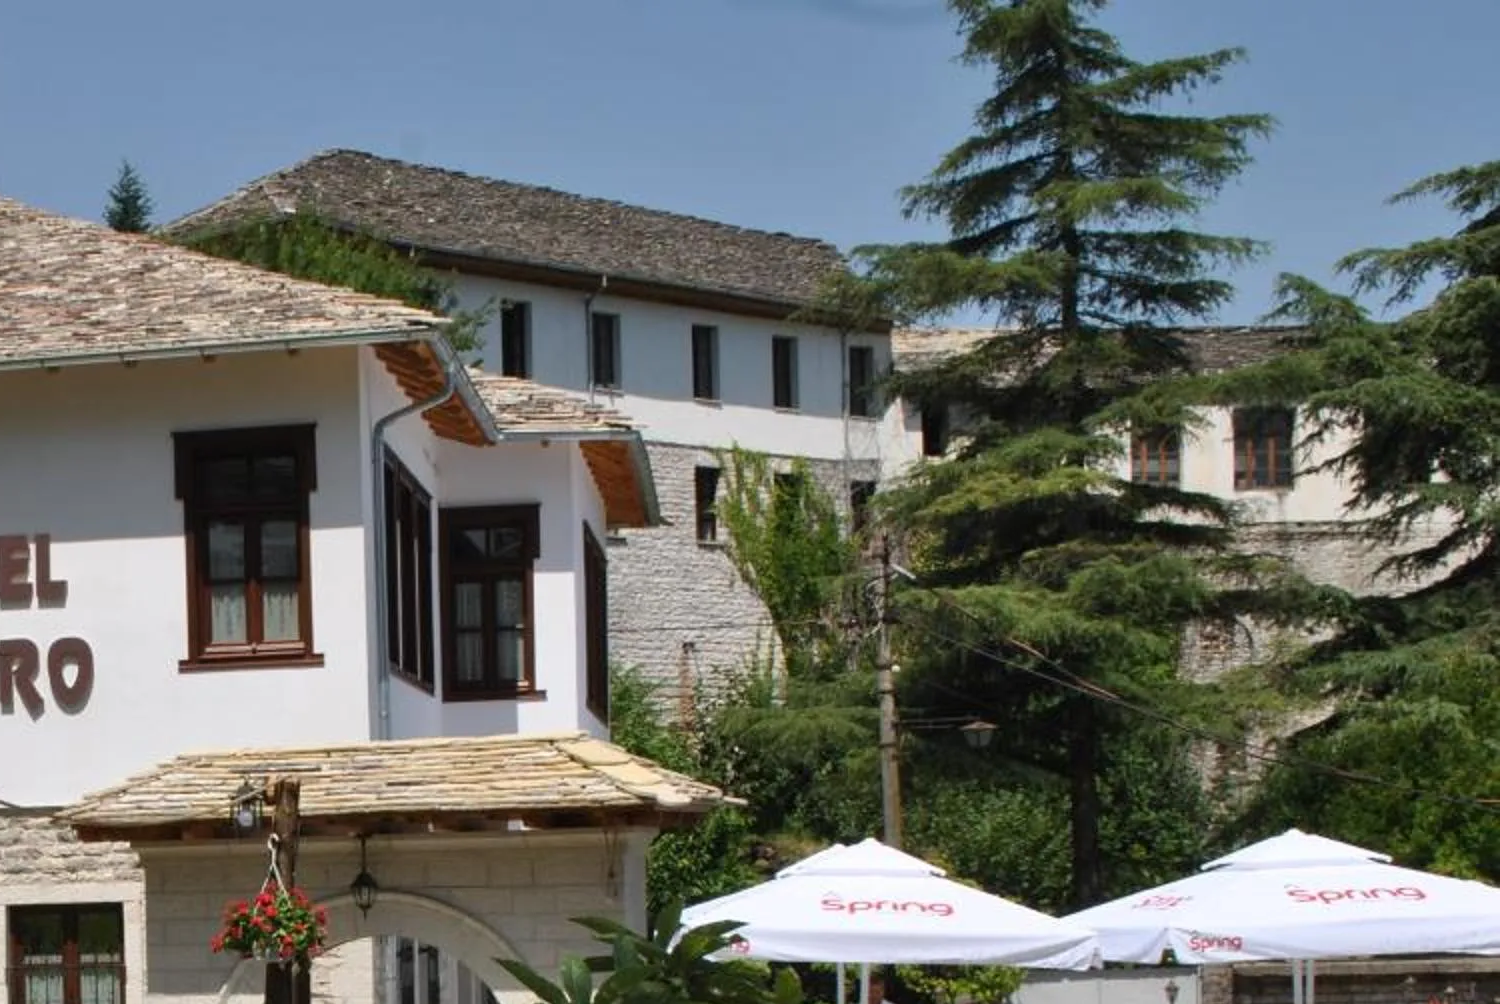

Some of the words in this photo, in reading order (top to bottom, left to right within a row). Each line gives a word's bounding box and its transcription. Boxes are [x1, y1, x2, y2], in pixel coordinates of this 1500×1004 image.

[1283, 882, 1426, 904] Spring
[821, 896, 955, 917] Spring
[1188, 934, 1243, 953] Spring
